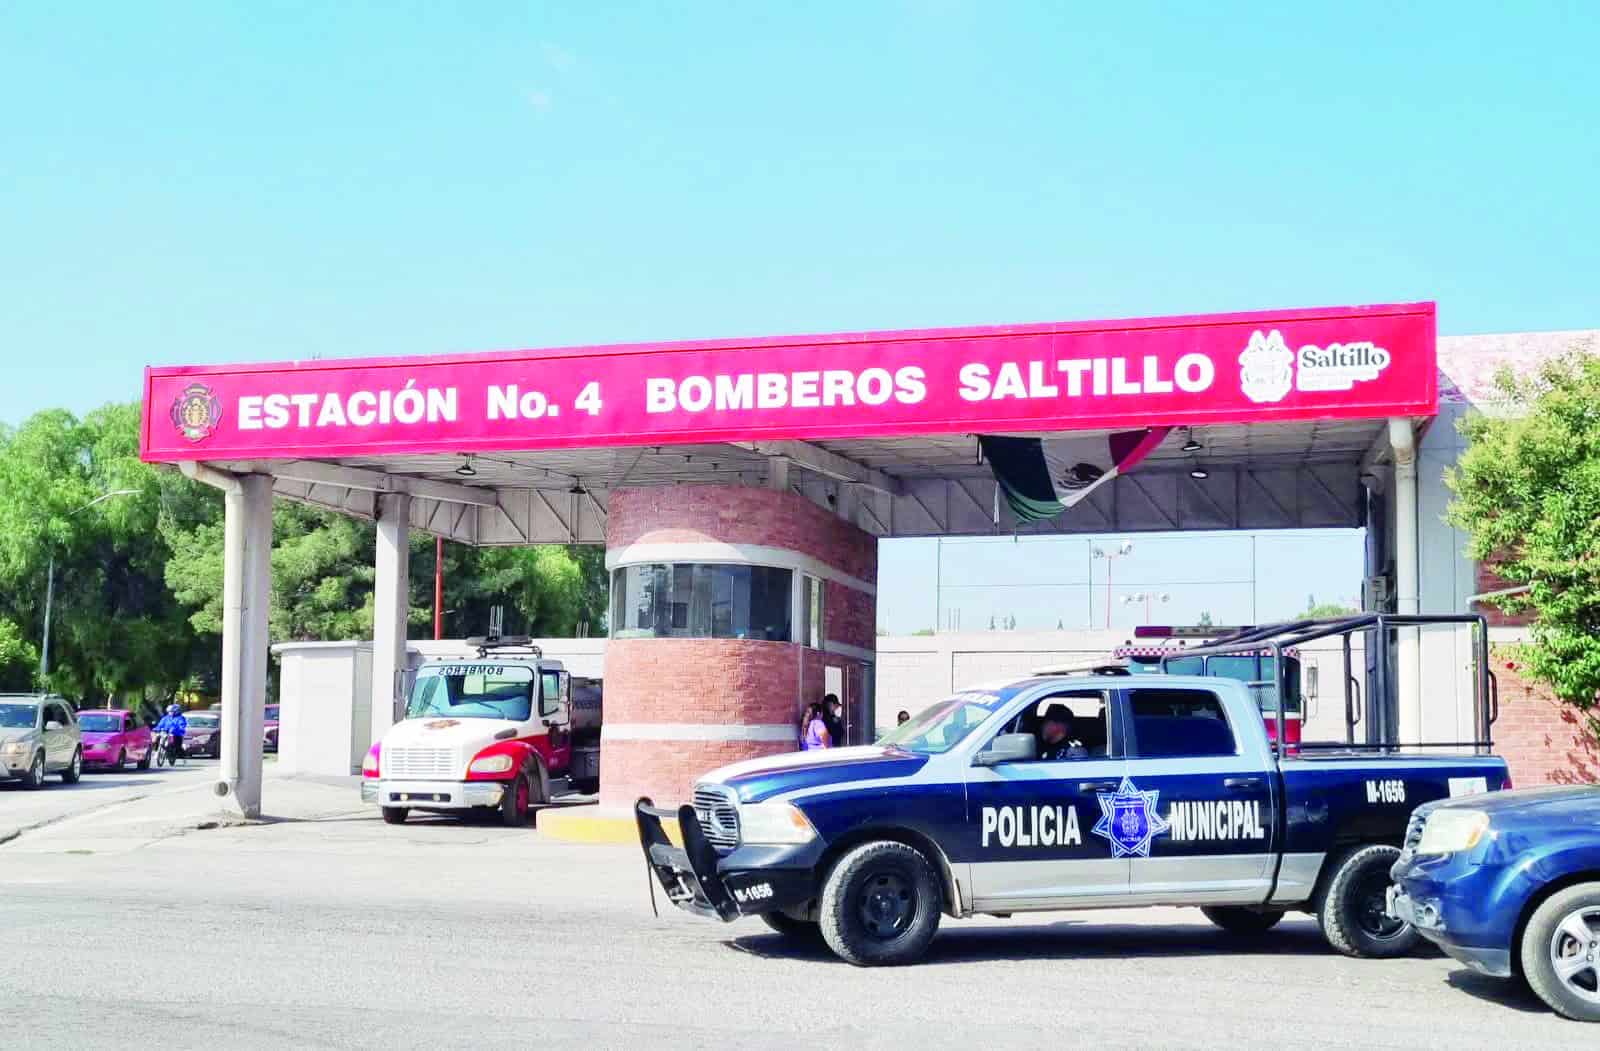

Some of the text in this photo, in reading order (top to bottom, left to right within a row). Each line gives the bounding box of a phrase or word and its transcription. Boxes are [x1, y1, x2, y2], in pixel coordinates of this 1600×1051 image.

[1302, 346, 1385, 369] Saltillo
[238, 353, 1214, 430] ESTACIÓN No. 4 BOMBEROS SALTILLO
[1366, 780, 1405, 803] M-1656
[982, 801, 1265, 847] POLICIA MUNICIPAL
